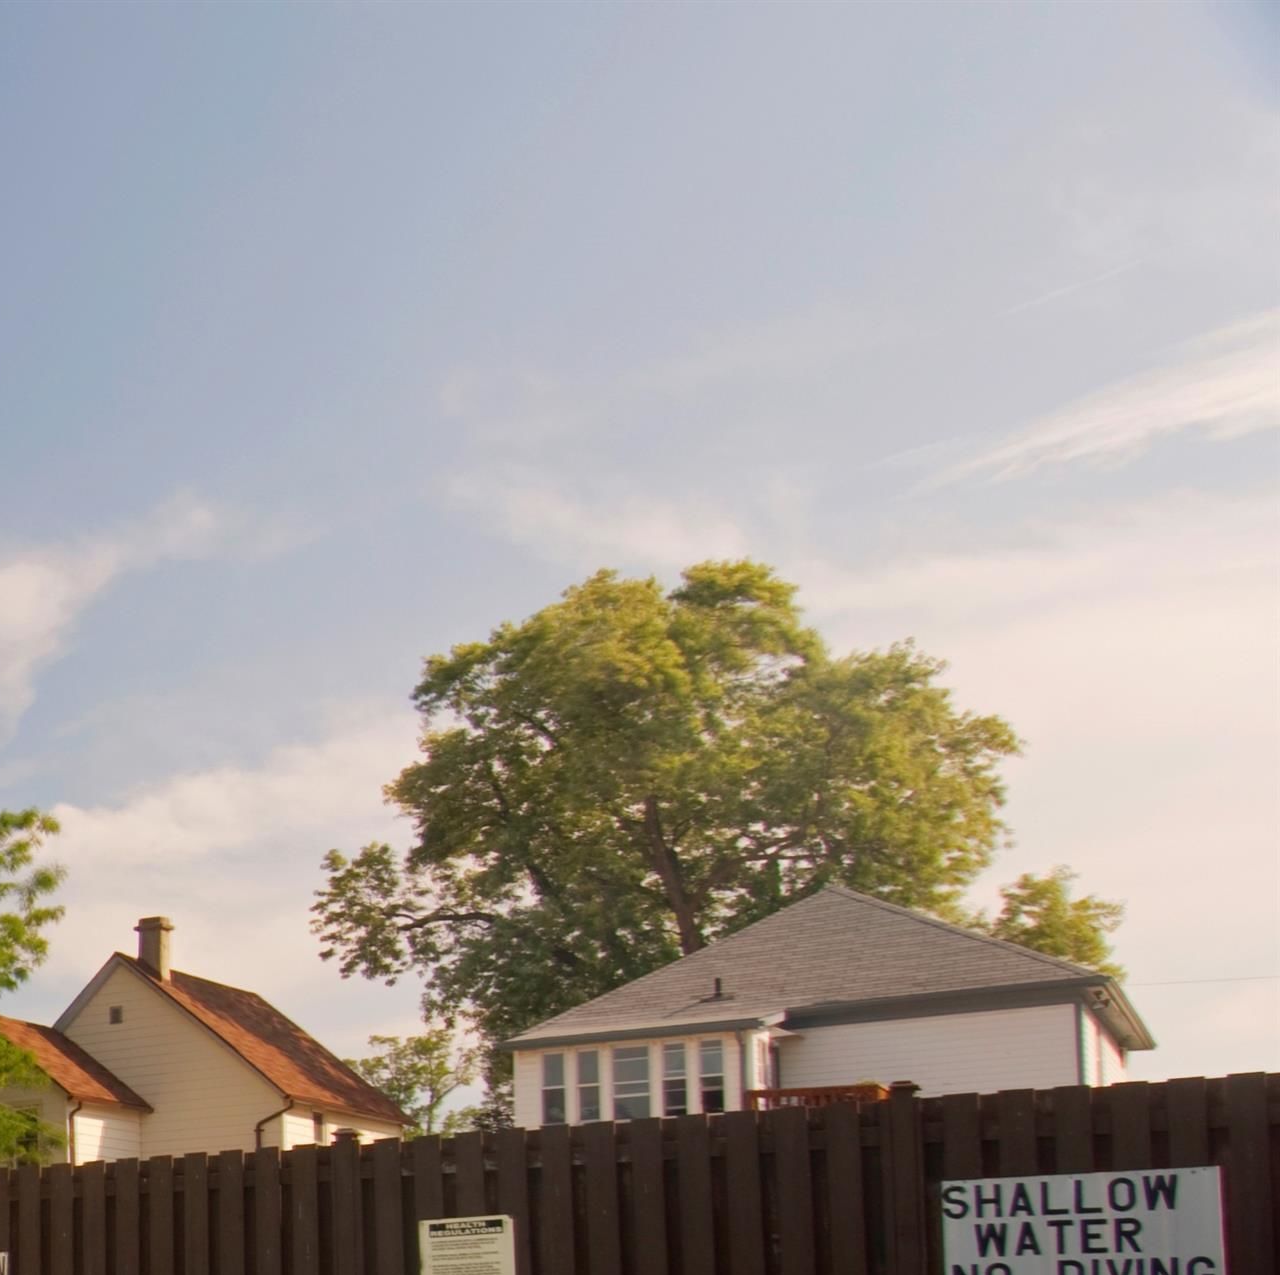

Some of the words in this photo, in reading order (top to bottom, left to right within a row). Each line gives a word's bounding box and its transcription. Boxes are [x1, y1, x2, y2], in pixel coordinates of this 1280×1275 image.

[942, 1174, 1178, 1219] SHALLOW
[430, 1226, 502, 1237] REGULATIONS
[445, 1221, 487, 1230] HEALTH
[974, 1218, 1143, 1257] WATER
